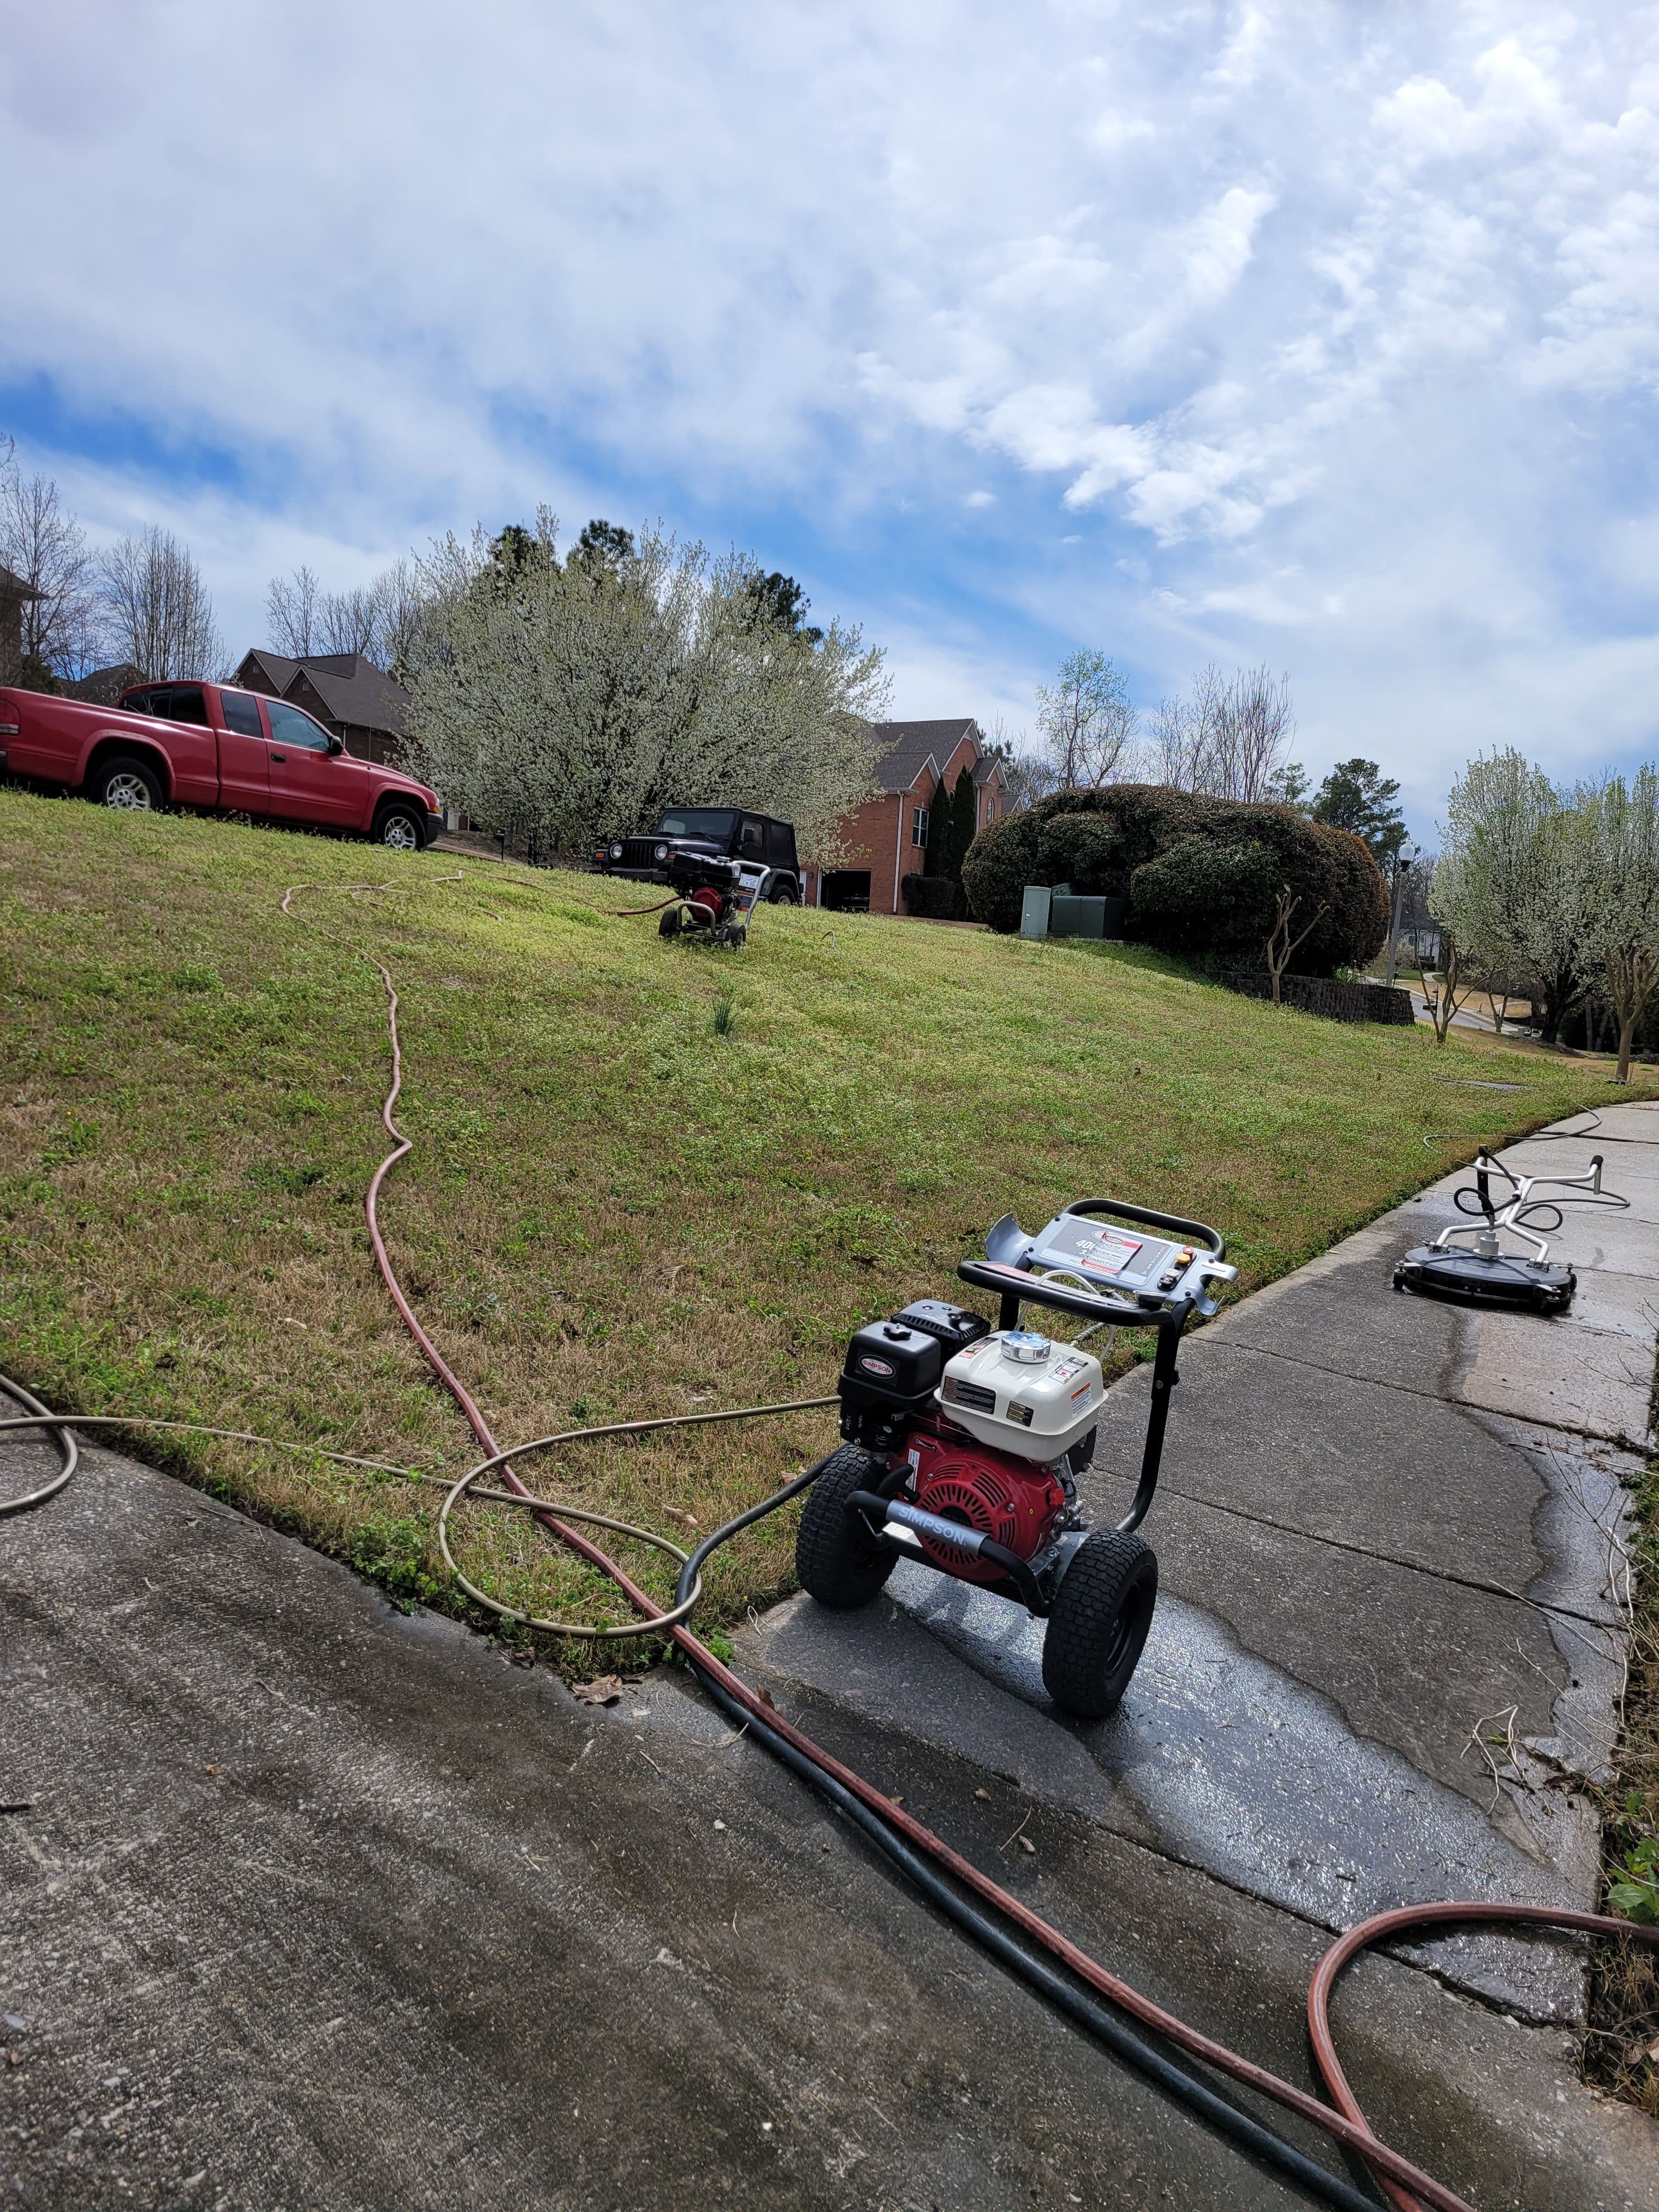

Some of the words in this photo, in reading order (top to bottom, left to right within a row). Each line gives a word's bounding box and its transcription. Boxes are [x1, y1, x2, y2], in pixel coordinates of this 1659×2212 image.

[1099, 1240, 1122, 1250] REGISTER
[1093, 1248, 1112, 1256] REVIEW
[1086, 1256, 1110, 1265] CONNECT
[864, 1360, 890, 1373] SIMPSON
[898, 1506, 966, 1545] SIMPSON
